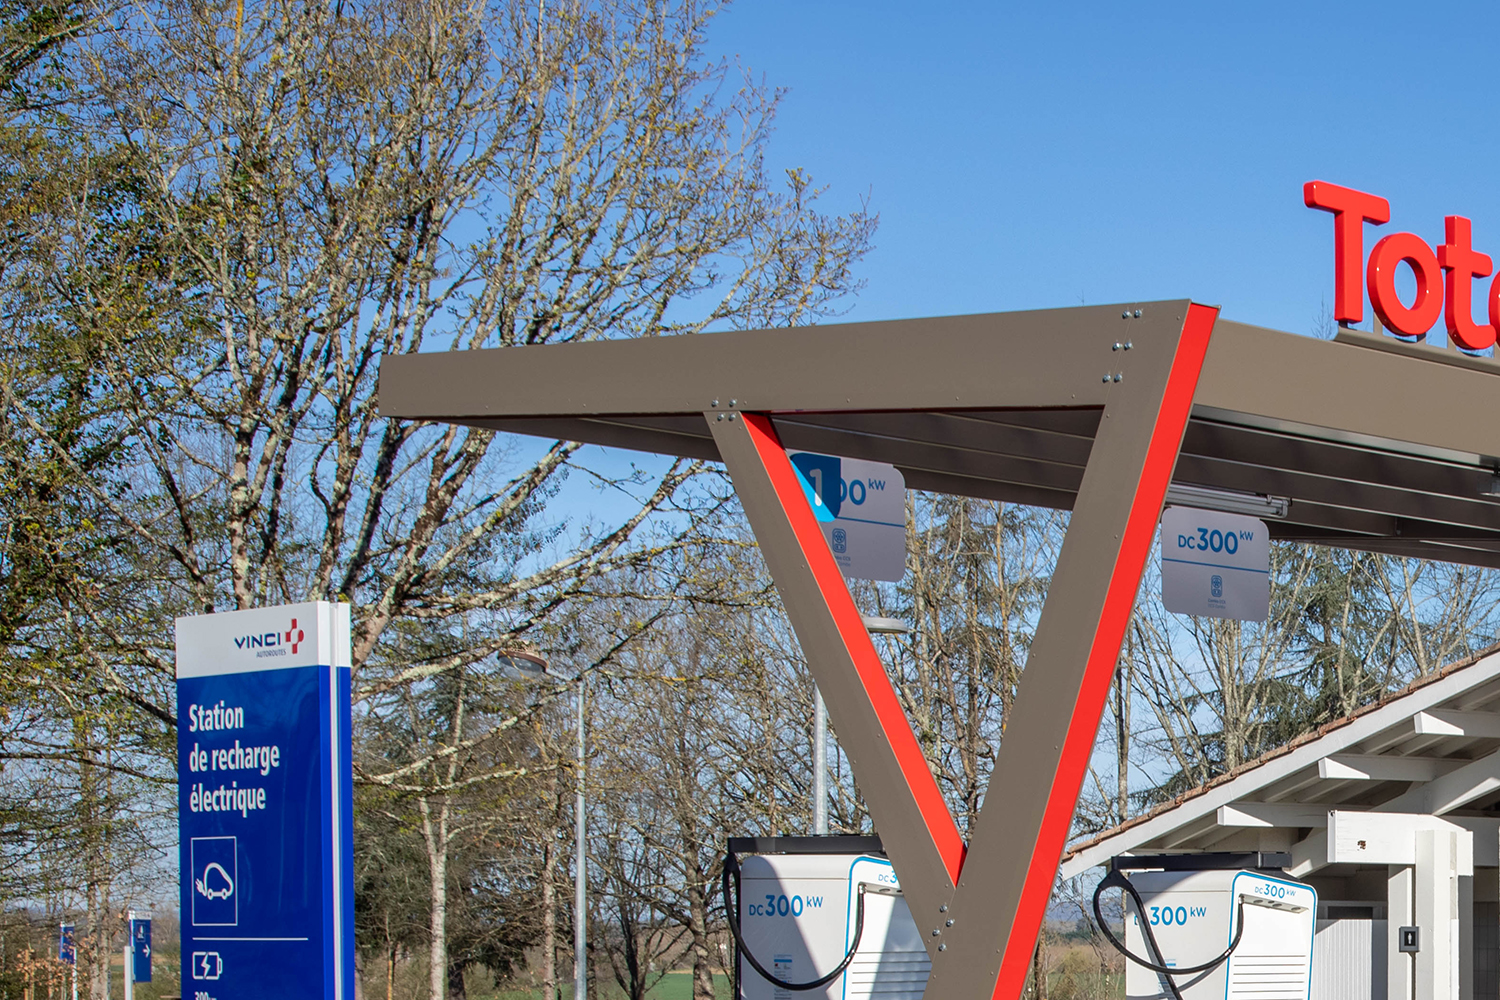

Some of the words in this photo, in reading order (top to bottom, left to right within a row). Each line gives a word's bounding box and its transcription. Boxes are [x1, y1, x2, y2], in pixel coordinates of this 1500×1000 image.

[809, 468, 823, 507] 1
[868, 478, 886, 491] kW
[1178, 534, 1195, 549] DC
[1197, 527, 1239, 555] 300
[1240, 530, 1254, 541] kW
[234, 632, 281, 649] VINCI
[256, 649, 287, 659] AUTOROUTES
[189, 700, 245, 733] Station
[189, 742, 208, 773] de
[211, 740, 280, 776] recharge
[189, 780, 266, 818] électrique
[878, 873, 889, 882] DC
[1254, 886, 1264, 895] DC
[1264, 883, 1286, 899] 300
[749, 904, 764, 916] DC
[765, 895, 804, 917] 300
[806, 896, 823, 908] kW
[1150, 906, 1188, 926] 300
[1190, 906, 1207, 918] kW
